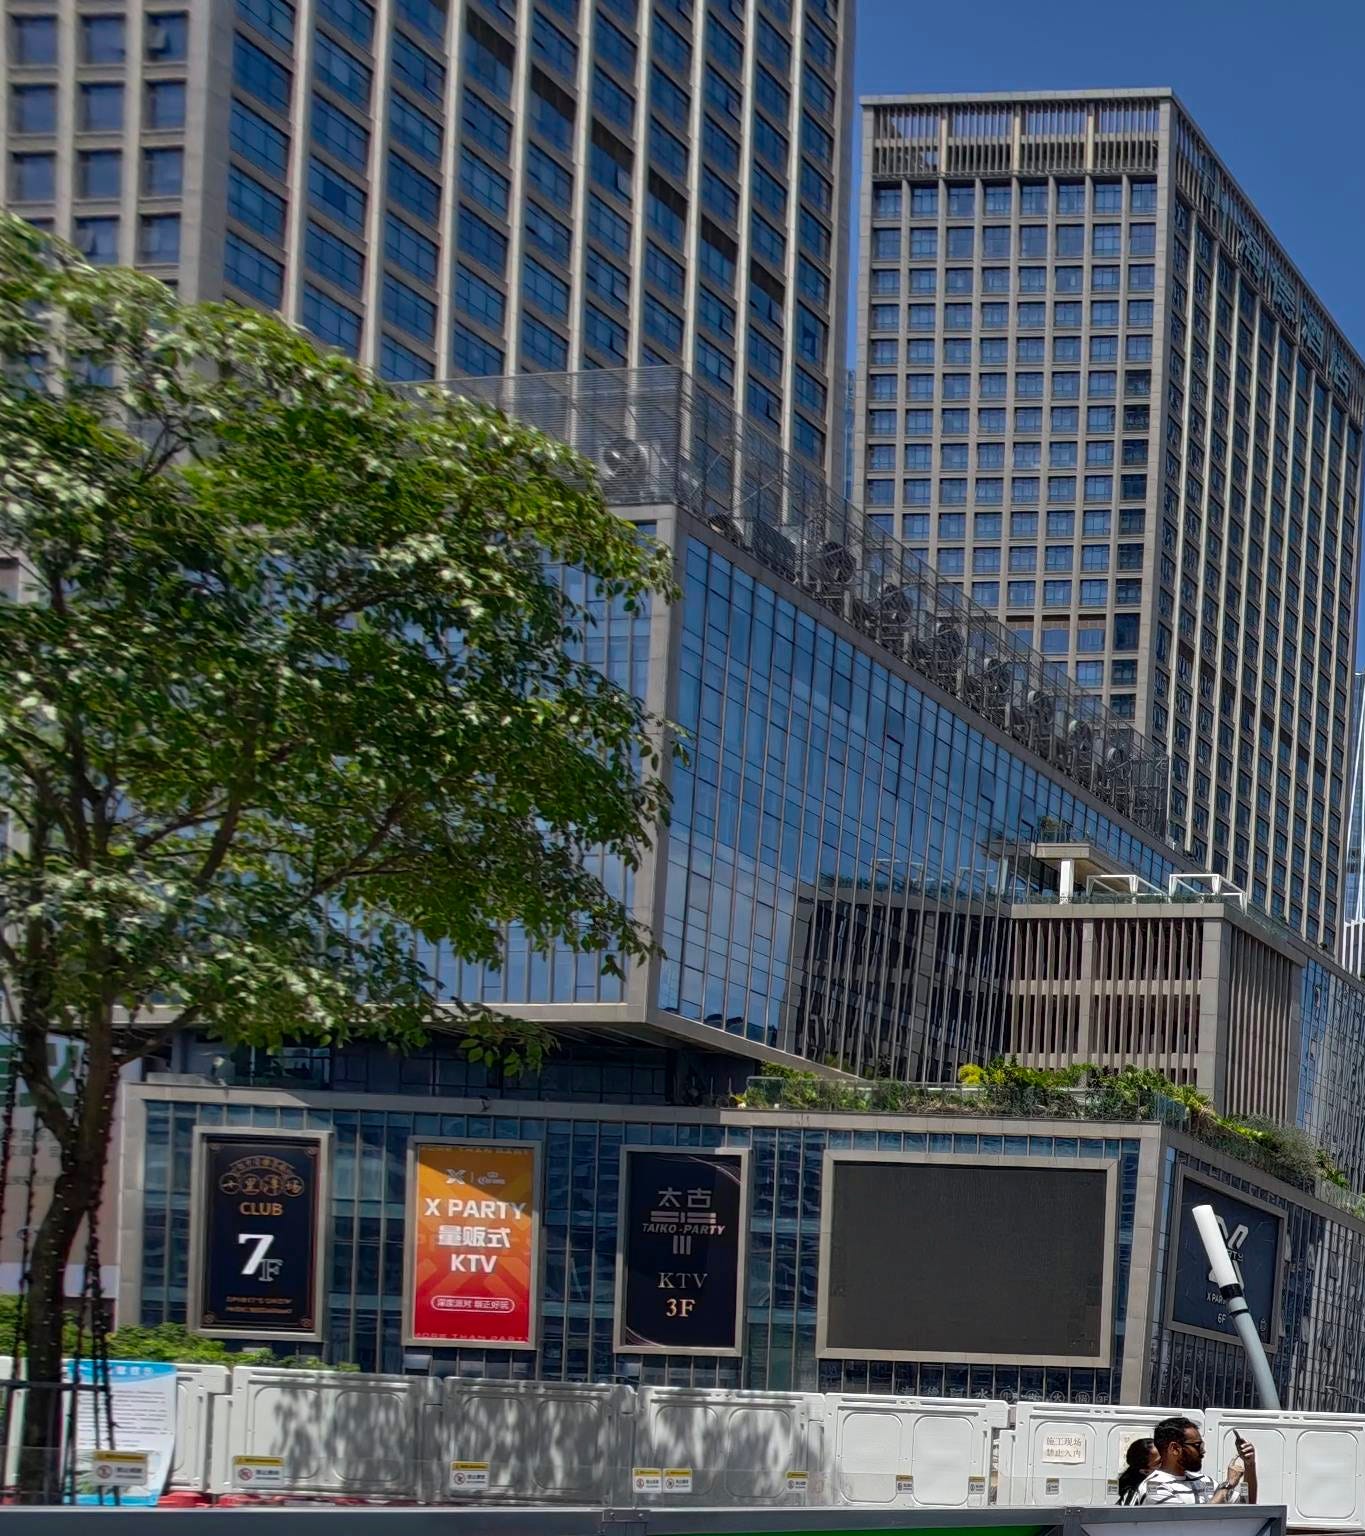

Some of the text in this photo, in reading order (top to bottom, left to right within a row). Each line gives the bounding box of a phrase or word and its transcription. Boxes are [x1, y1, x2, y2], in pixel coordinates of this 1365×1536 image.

[658, 1187, 712, 1208] 太古
[239, 1201, 284, 1216] CLUB
[424, 1197, 527, 1220] X PARTY
[437, 1224, 512, 1249] 量贩式
[450, 1253, 498, 1273] KTV
[658, 1271, 709, 1289] KTV
[665, 1298, 696, 1318] 3F
